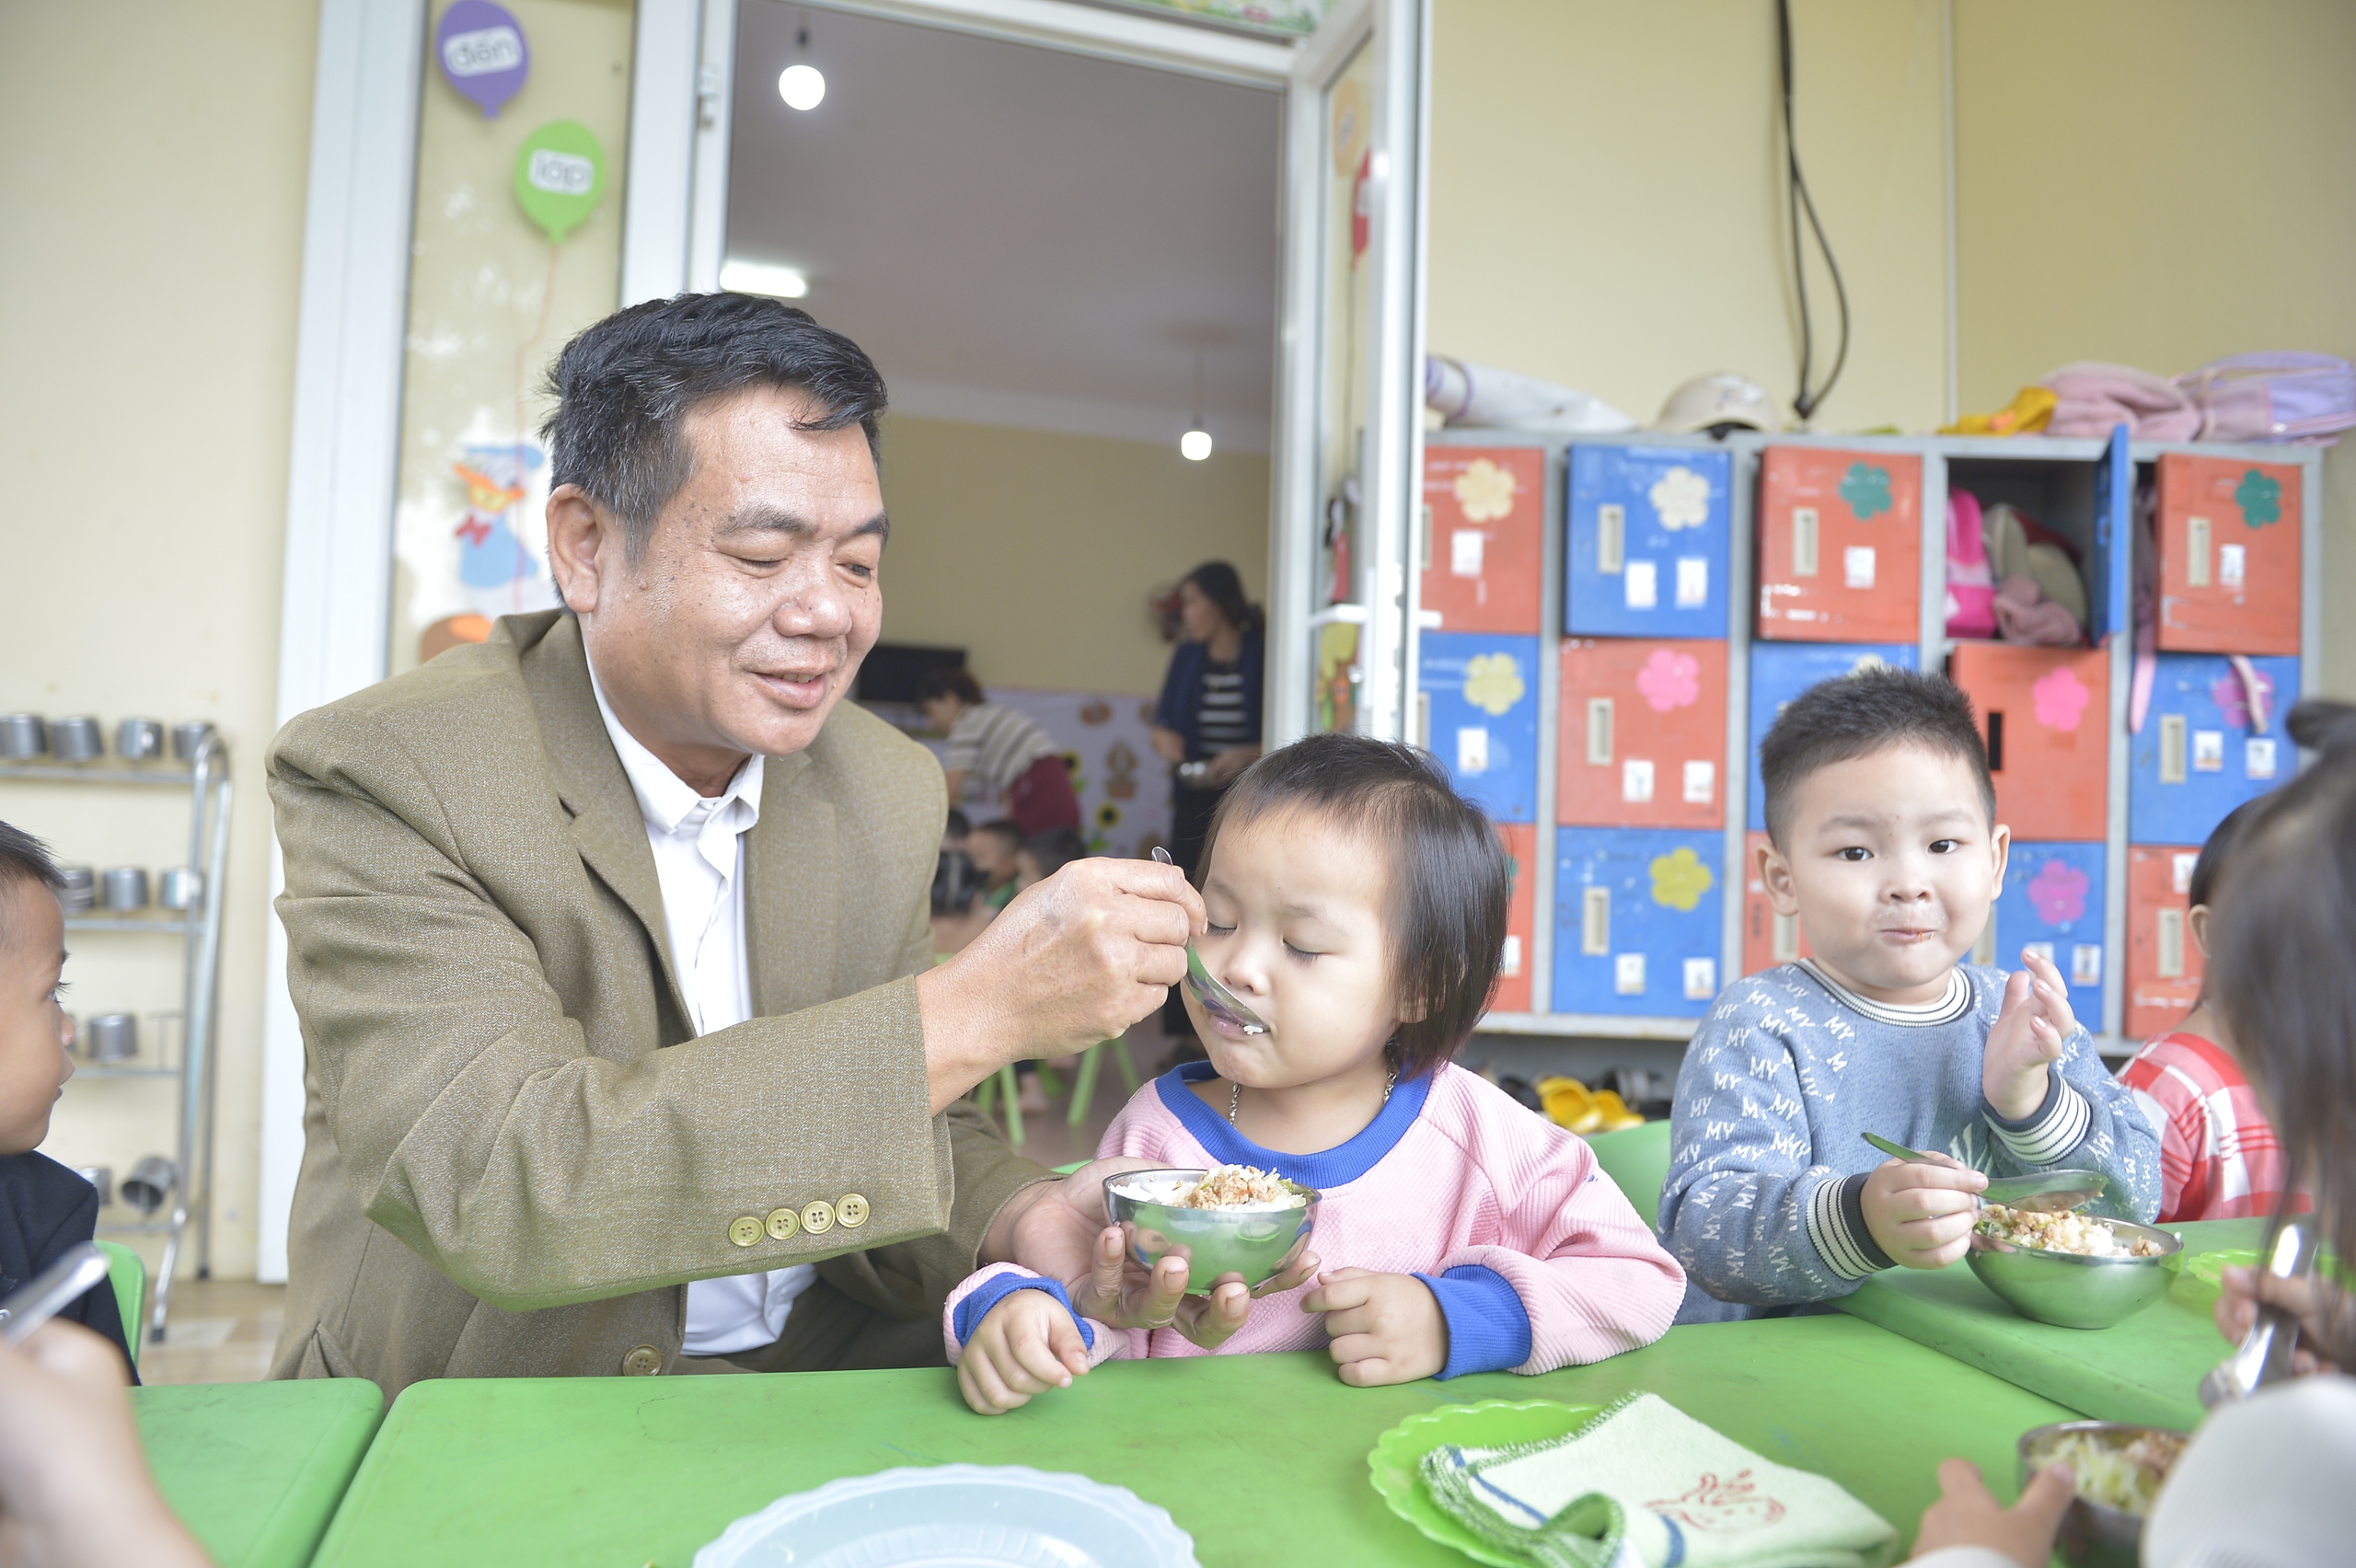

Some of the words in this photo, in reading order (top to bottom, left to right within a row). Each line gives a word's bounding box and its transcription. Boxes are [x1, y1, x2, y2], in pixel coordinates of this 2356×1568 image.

[1726, 1026, 1751, 1047] MY
[1759, 1012, 1793, 1039] MY
[1823, 1015, 1855, 1041] MY
[1713, 1070, 1741, 1091] MY
[1749, 1055, 1782, 1082] MY
[1690, 1095, 1713, 1119] MY
[1766, 1091, 1804, 1122] MY
[1704, 1120, 1737, 1141] MY
[1731, 1144, 1766, 1162] MY
